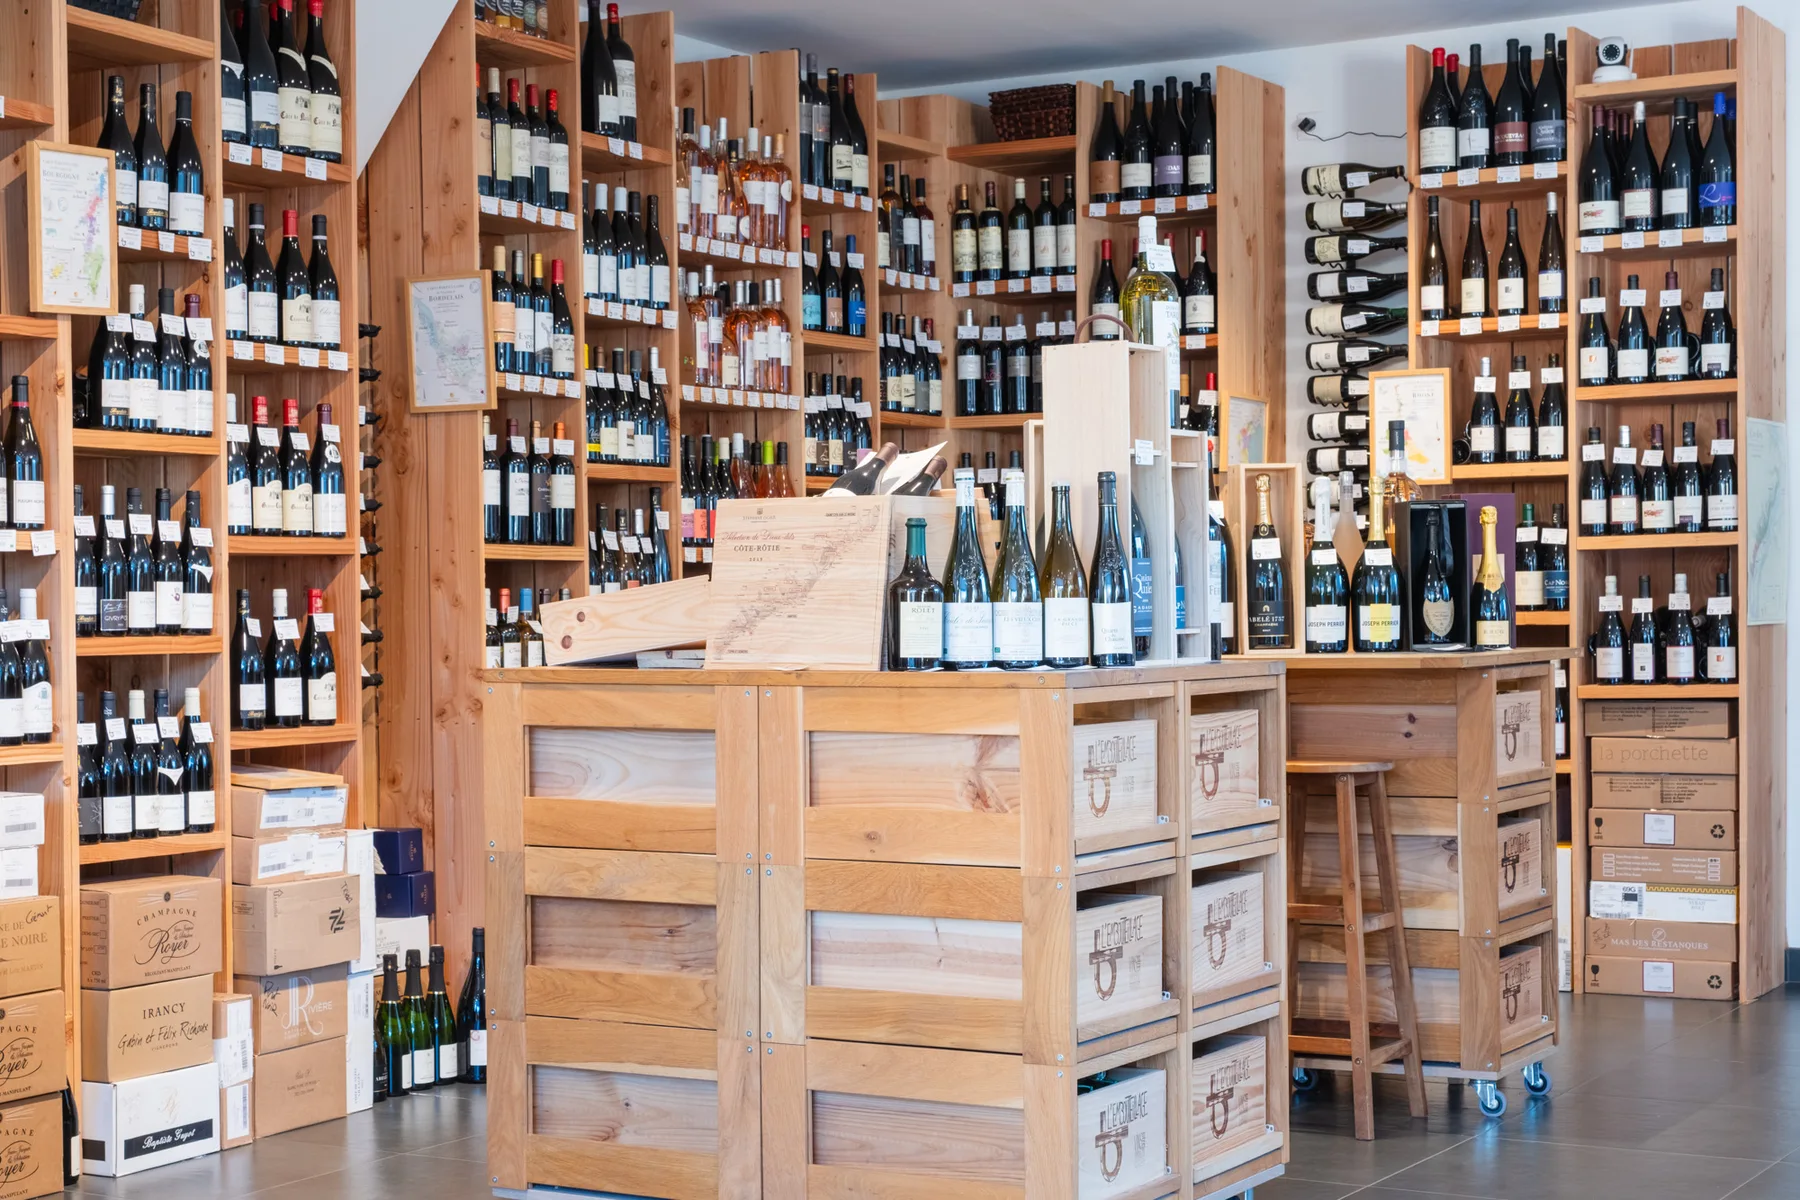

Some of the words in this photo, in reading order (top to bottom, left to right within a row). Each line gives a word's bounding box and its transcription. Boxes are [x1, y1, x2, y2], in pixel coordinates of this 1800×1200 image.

[733, 544, 781, 552] CÔTE-RÔTIE
[1308, 620, 1326, 628] JOSEPH
[1327, 620, 1345, 628] PERRIER
[1361, 620, 1379, 628] JOSEPH
[1380, 620, 1399, 628] PERRIER
[1599, 745, 1614, 760] la
[1620, 745, 1709, 763] porchette
[137, 908, 197, 926] CHAMPAGNE
[13, 921, 25, 930] DE
[12, 932, 48, 947] NOIRE
[1611, 938, 1630, 946] MAS
[1632, 939, 1649, 948] DES
[1651, 940, 1709, 950] RESTANQUES
[143, 1002, 186, 1020] IRANCY
[118, 1034, 143, 1055] Gabin
[146, 1027, 156, 1045] et
[157, 1024, 177, 1043] Félix
[142, 1134, 173, 1150] Baptiste
[174, 1128, 197, 1143] Guyot
